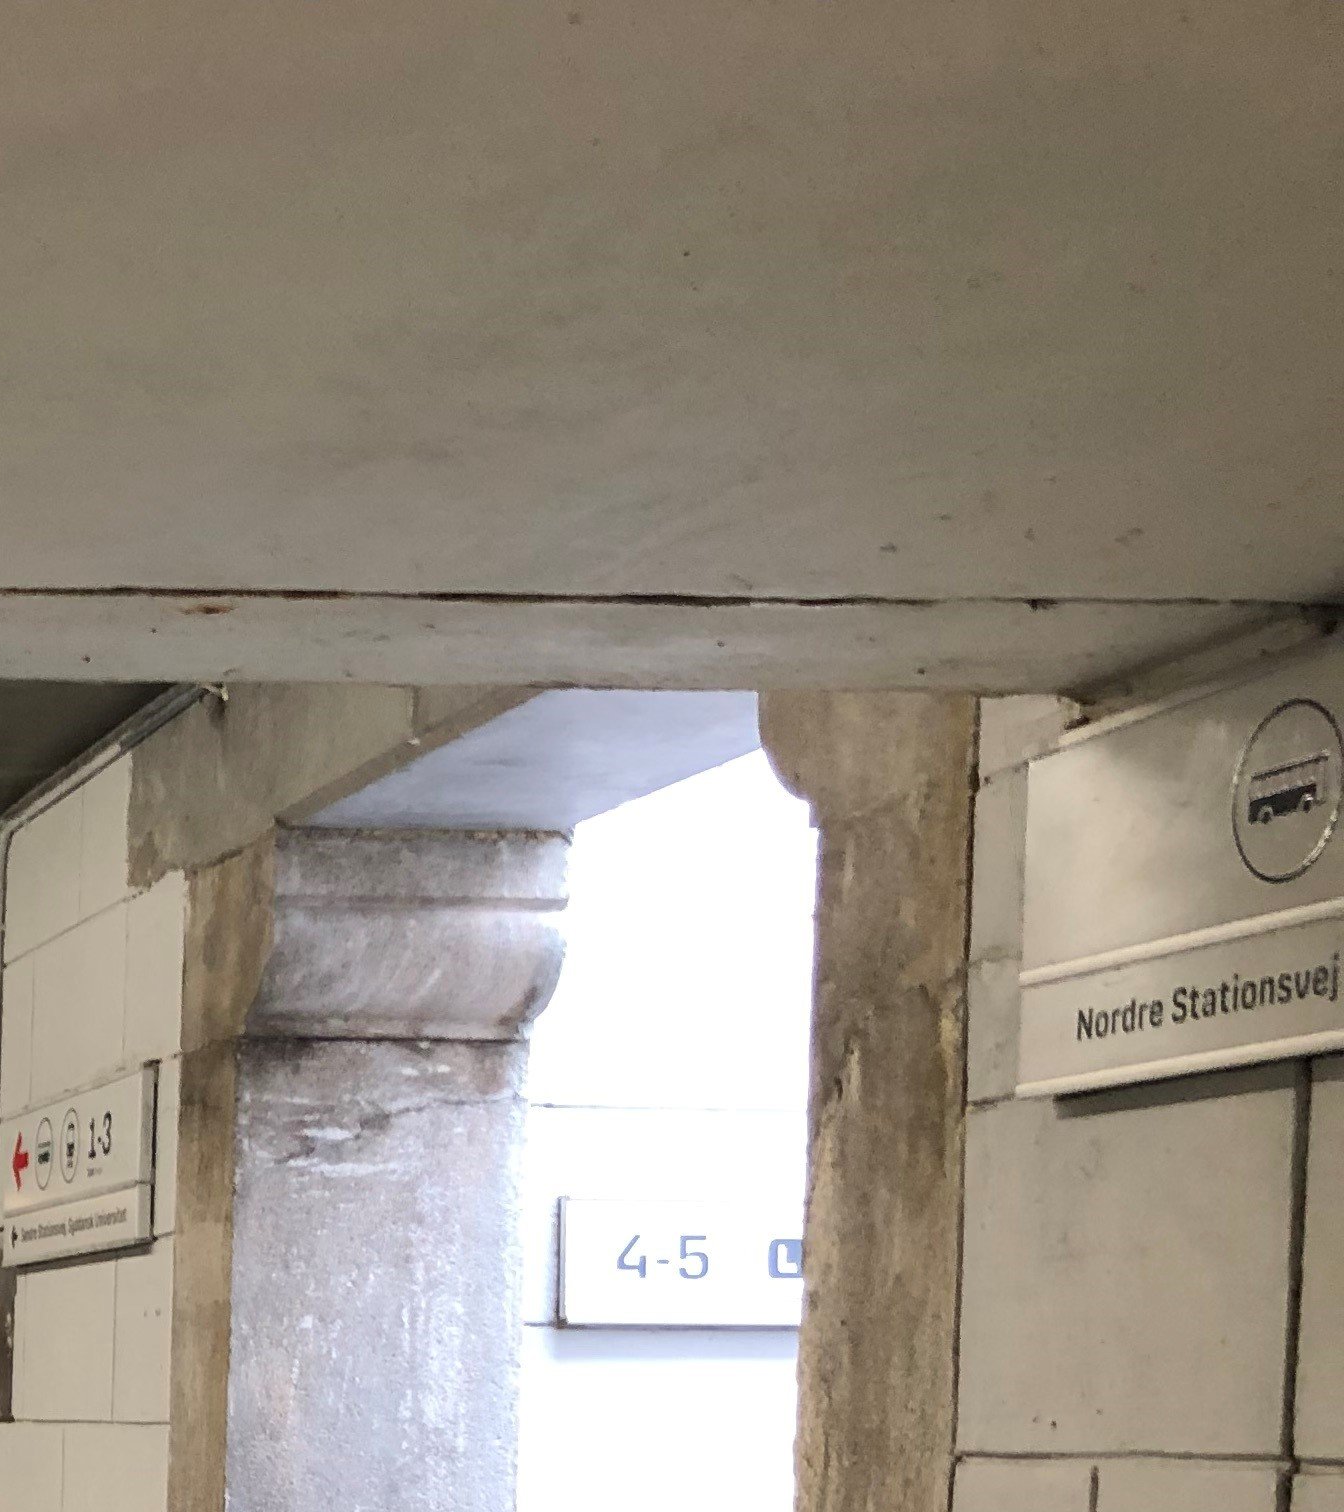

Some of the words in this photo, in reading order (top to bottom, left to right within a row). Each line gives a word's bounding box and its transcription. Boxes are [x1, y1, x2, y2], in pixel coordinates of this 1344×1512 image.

[1076, 997, 1164, 1043] Nordre
[1170, 950, 1340, 1025] Stationsvej
[616, 1234, 709, 1280] 4-5
